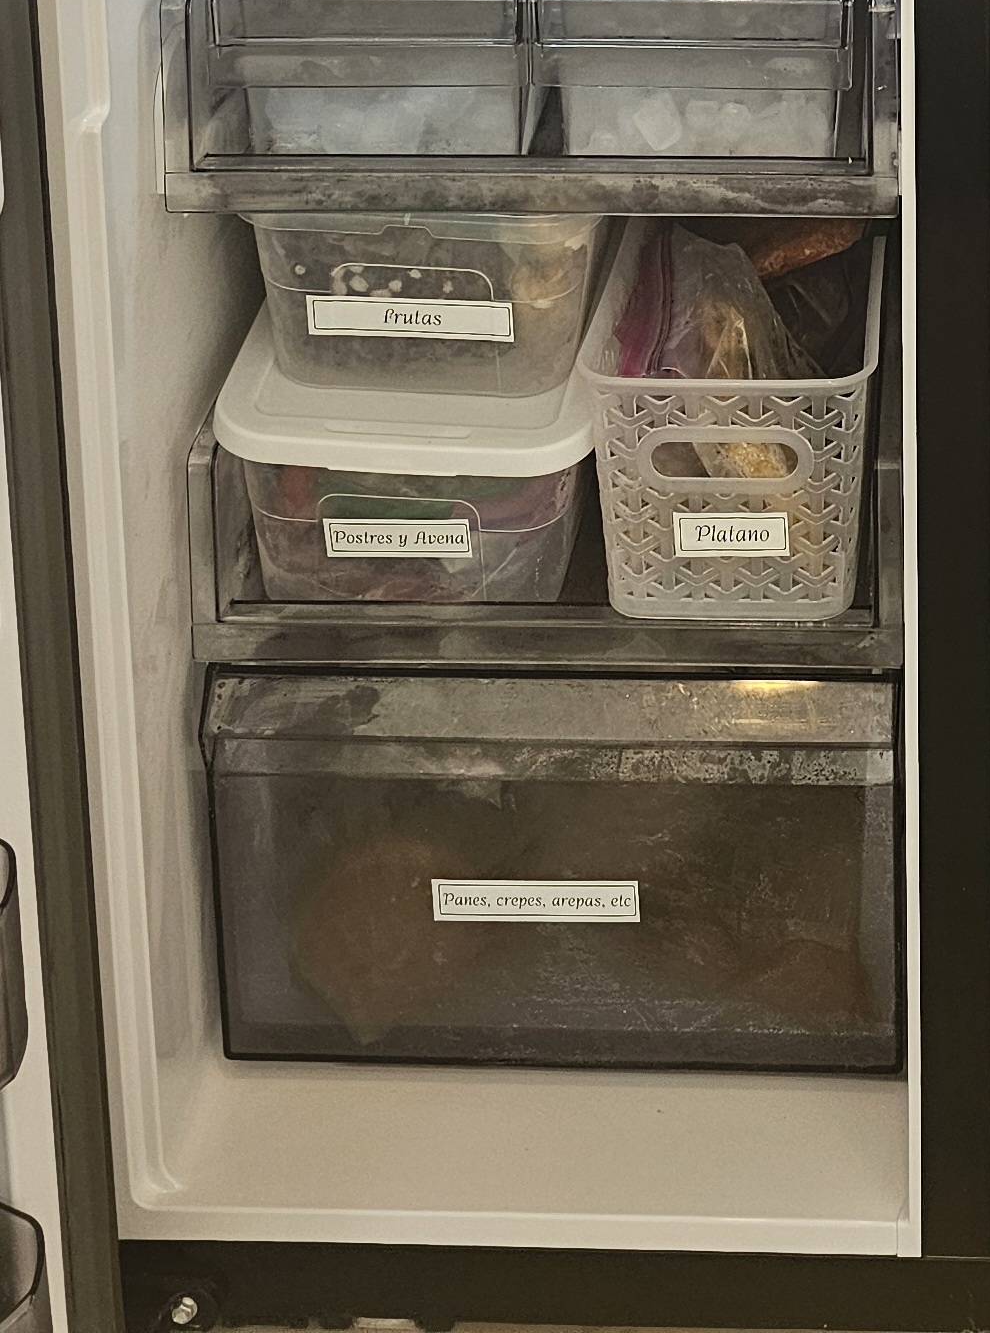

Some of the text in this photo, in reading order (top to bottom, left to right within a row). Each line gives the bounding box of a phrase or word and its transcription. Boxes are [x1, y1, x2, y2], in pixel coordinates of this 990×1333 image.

[333, 530, 465, 547] Postres y Avena
[694, 524, 770, 543] Platano
[442, 892, 632, 910] Panes, crepes, arepas, etc
